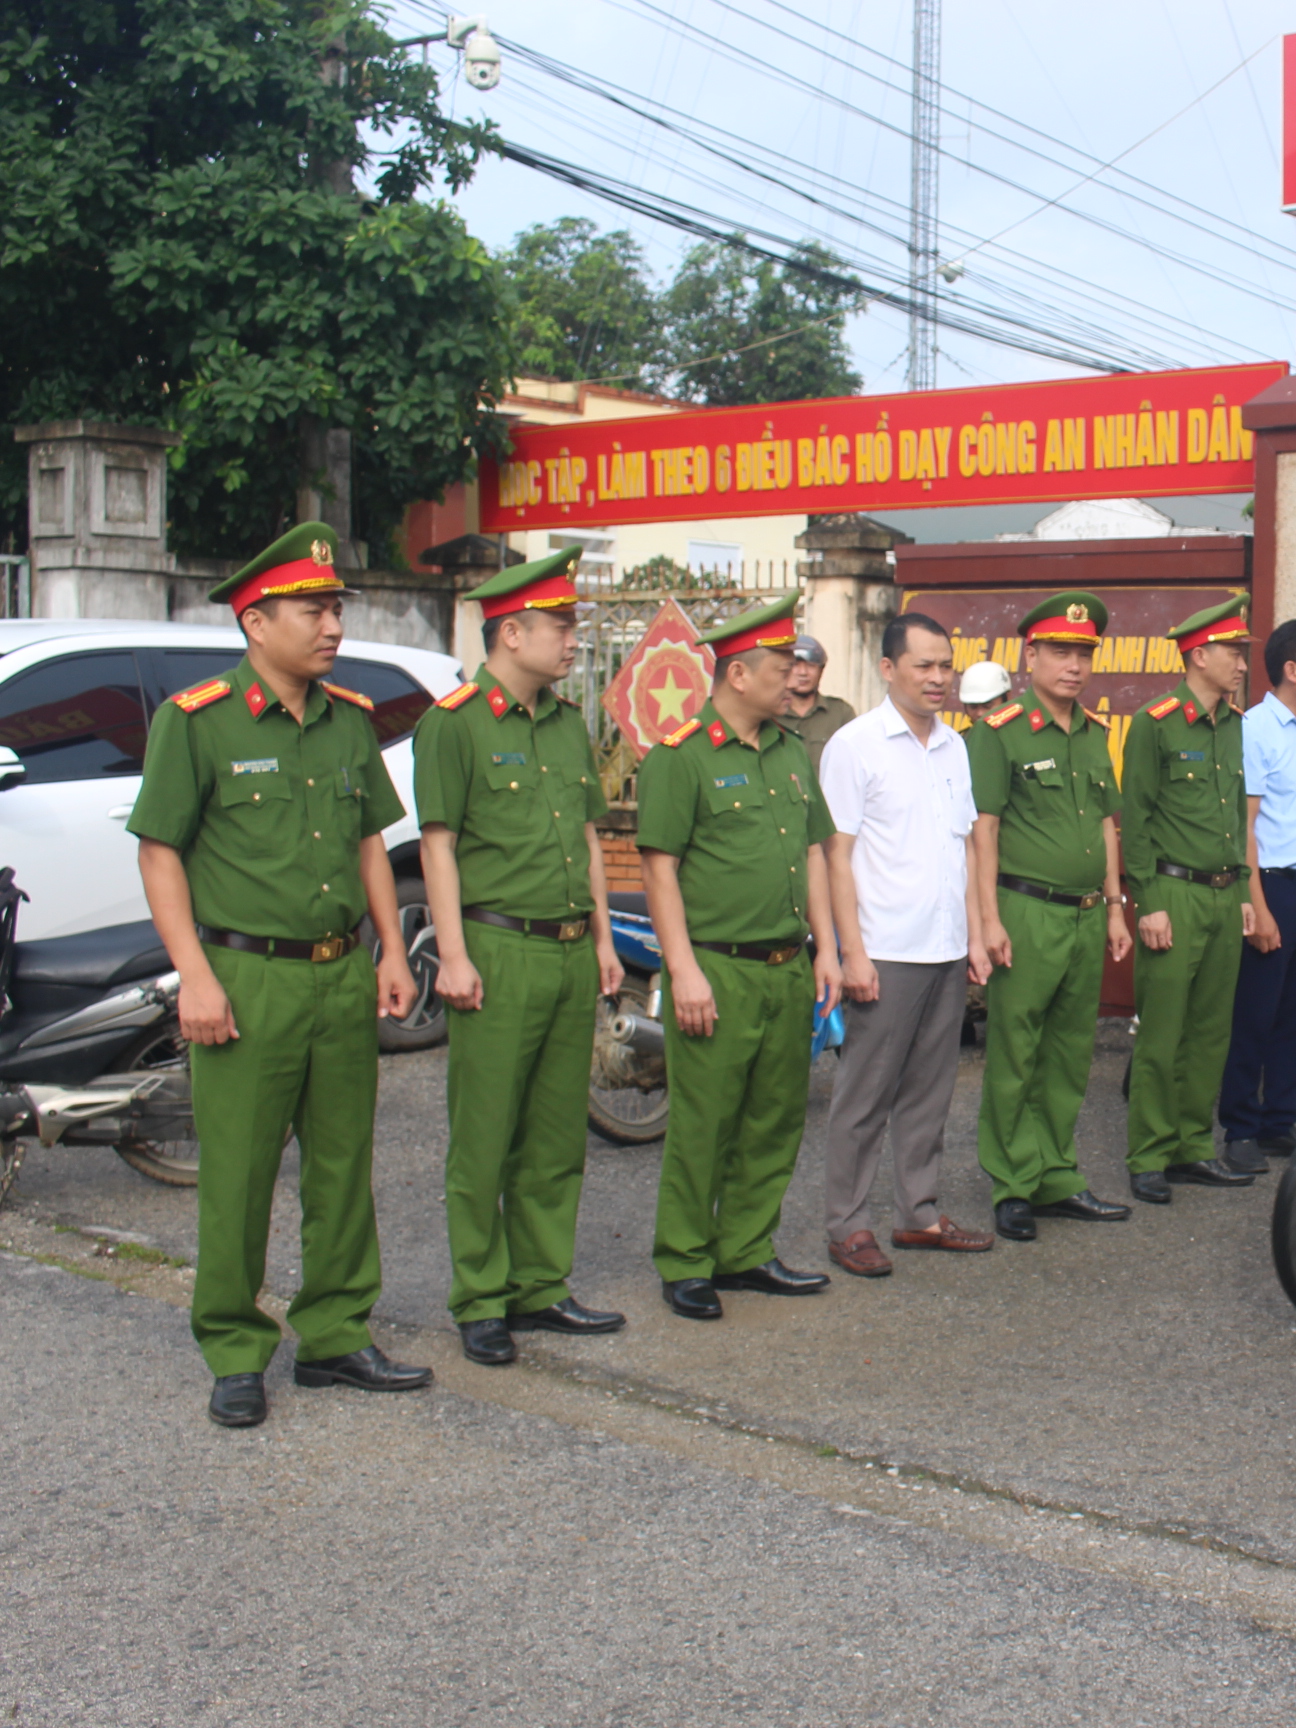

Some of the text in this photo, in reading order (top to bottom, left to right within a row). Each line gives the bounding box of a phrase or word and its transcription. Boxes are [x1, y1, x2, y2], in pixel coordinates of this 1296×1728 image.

[597, 441, 647, 501] LÀM
[650, 445, 710, 497] THEO
[715, 445, 731, 493] 6
[735, 421, 792, 492] ĐIỀU
[797, 424, 850, 488] BÁC
[855, 411, 893, 484] HỒ
[899, 426, 952, 490] DẠY
[958, 411, 1036, 478] CÔNG
[1043, 417, 1086, 473] AN
[1093, 400, 1179, 470] NHÂN
[1187, 394, 1253, 464] DÂN
[949, 626, 988, 674] ÔNG
[1091, 636, 1145, 674] ANH
